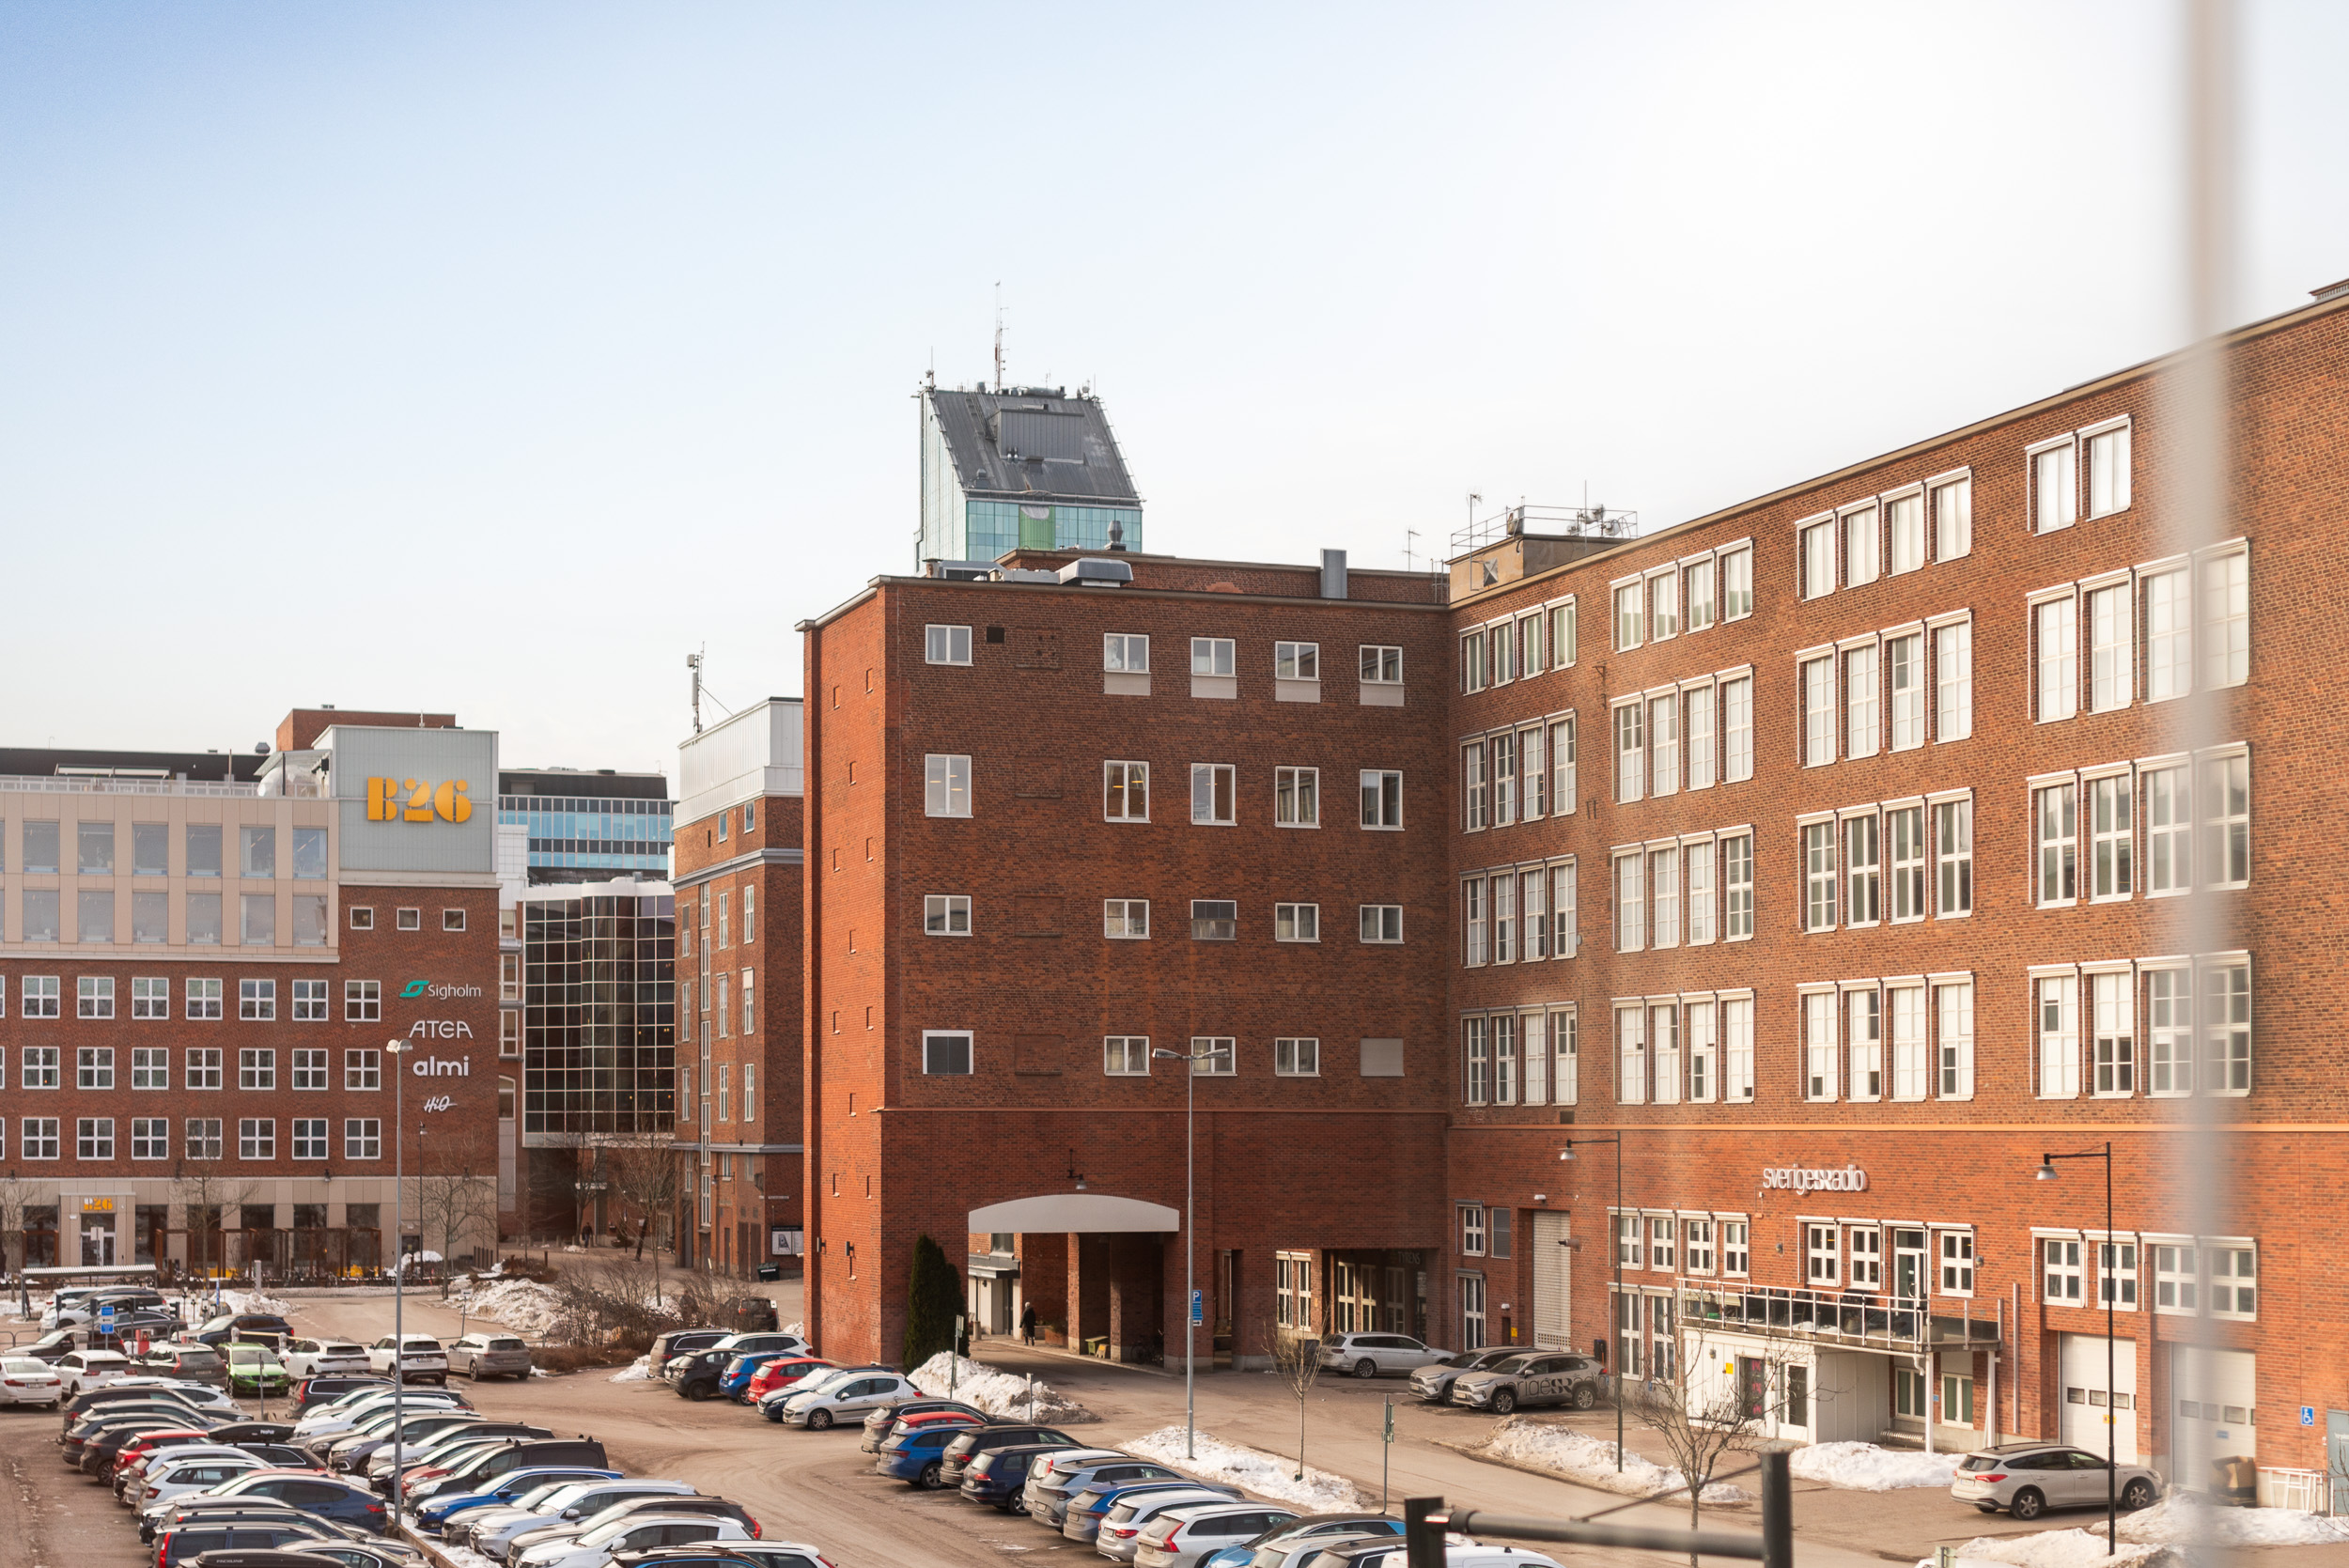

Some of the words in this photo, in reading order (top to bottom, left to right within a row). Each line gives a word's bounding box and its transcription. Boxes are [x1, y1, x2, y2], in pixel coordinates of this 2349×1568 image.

[367, 777, 473, 823] B26
[428, 983, 481, 1000] Sigholm
[409, 1020, 474, 1039] ATEA
[412, 1055, 469, 1077] almi
[423, 1095, 458, 1113] HiQ
[84, 1197, 113, 1211] B26
[1192, 1291, 1200, 1301] P
